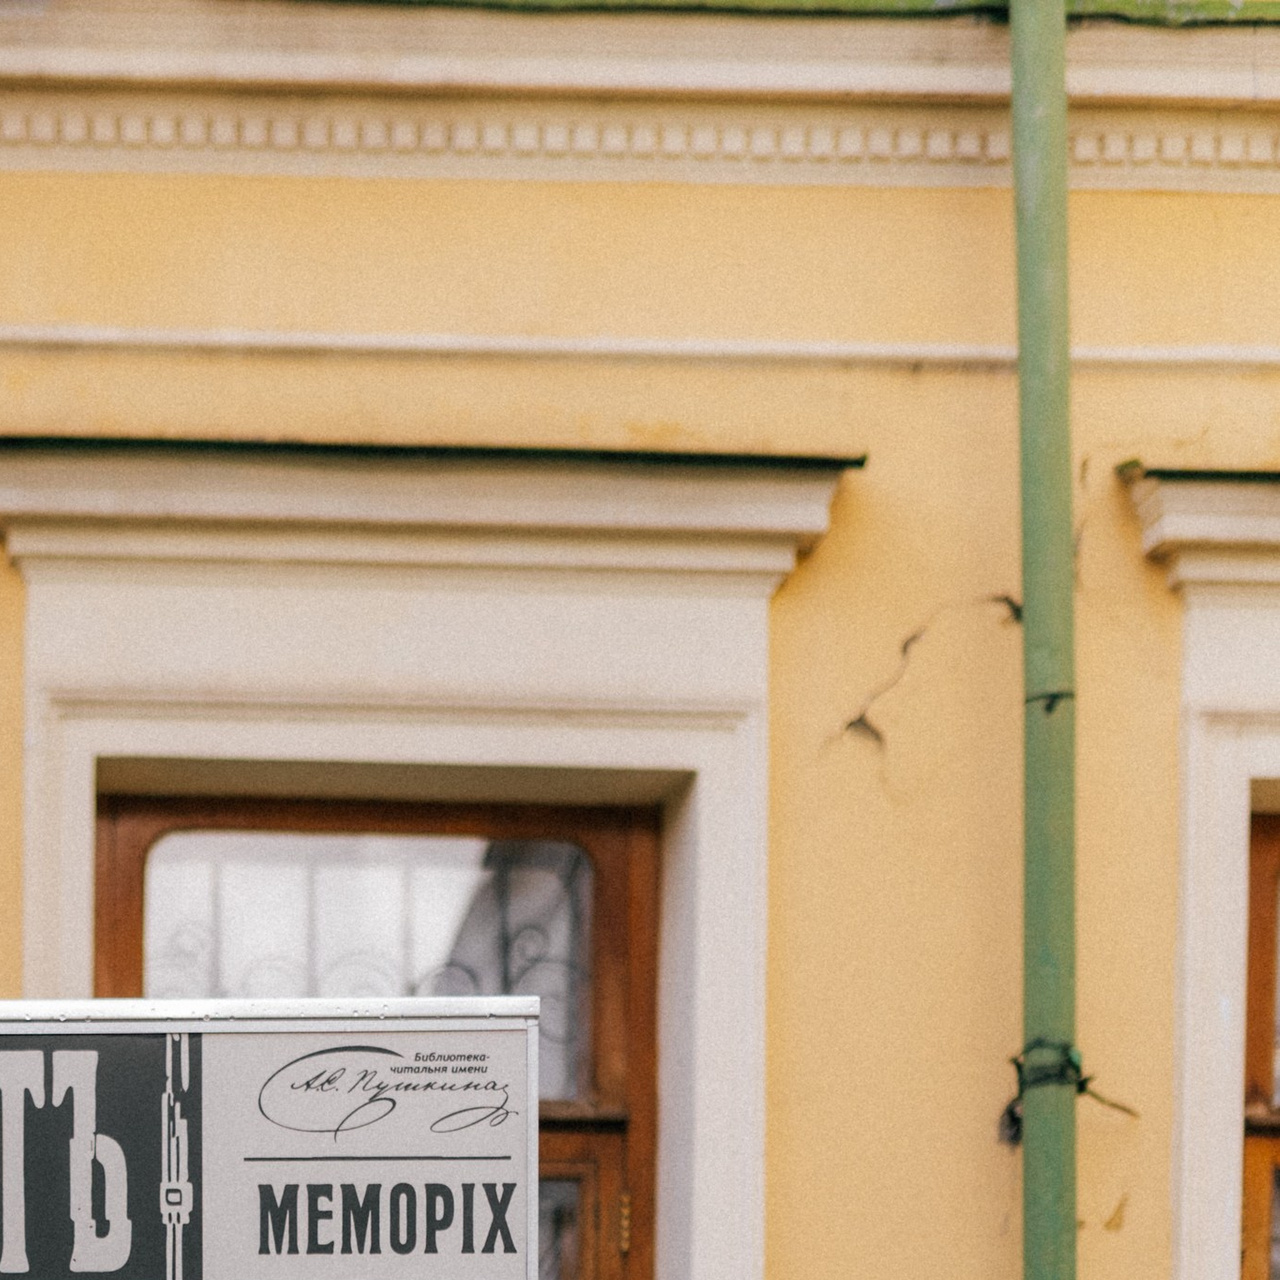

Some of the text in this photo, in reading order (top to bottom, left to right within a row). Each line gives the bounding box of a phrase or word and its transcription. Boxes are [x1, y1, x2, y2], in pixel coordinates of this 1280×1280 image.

[414, 1052, 490, 1063] Библиотека-
[390, 1064, 488, 1075] читальня имени
